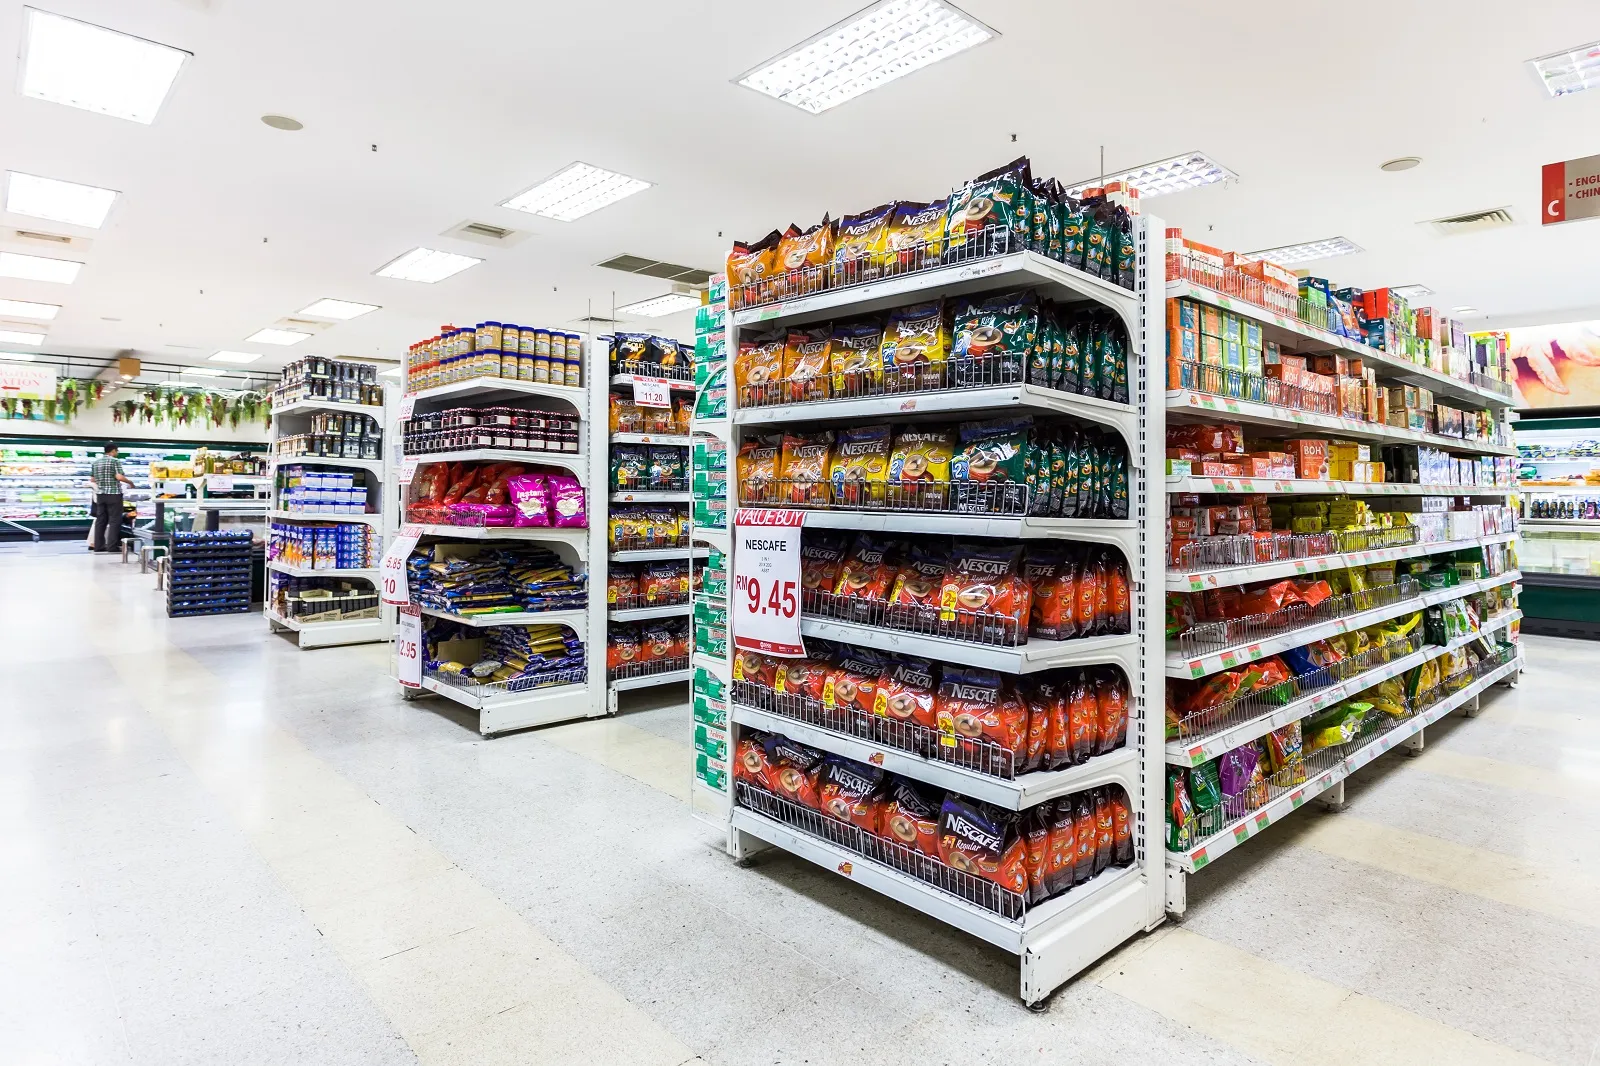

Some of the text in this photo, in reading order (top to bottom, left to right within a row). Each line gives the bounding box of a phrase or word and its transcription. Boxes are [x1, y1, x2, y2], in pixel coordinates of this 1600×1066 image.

[1548, 199, 1559, 216] C
[644, 392, 663, 402] 11.20
[1304, 445, 1322, 455] BOH
[737, 509, 803, 527] VALUE BUY
[745, 539, 787, 552] NESCAFE
[386, 557, 402, 570] 5.85
[736, 575, 796, 619] RM 9.45
[400, 639, 417, 659] 2.95
[961, 702, 991, 711] Regular
[946, 813, 1000, 854] NESCAFÉ
[955, 840, 981, 853] Regular
